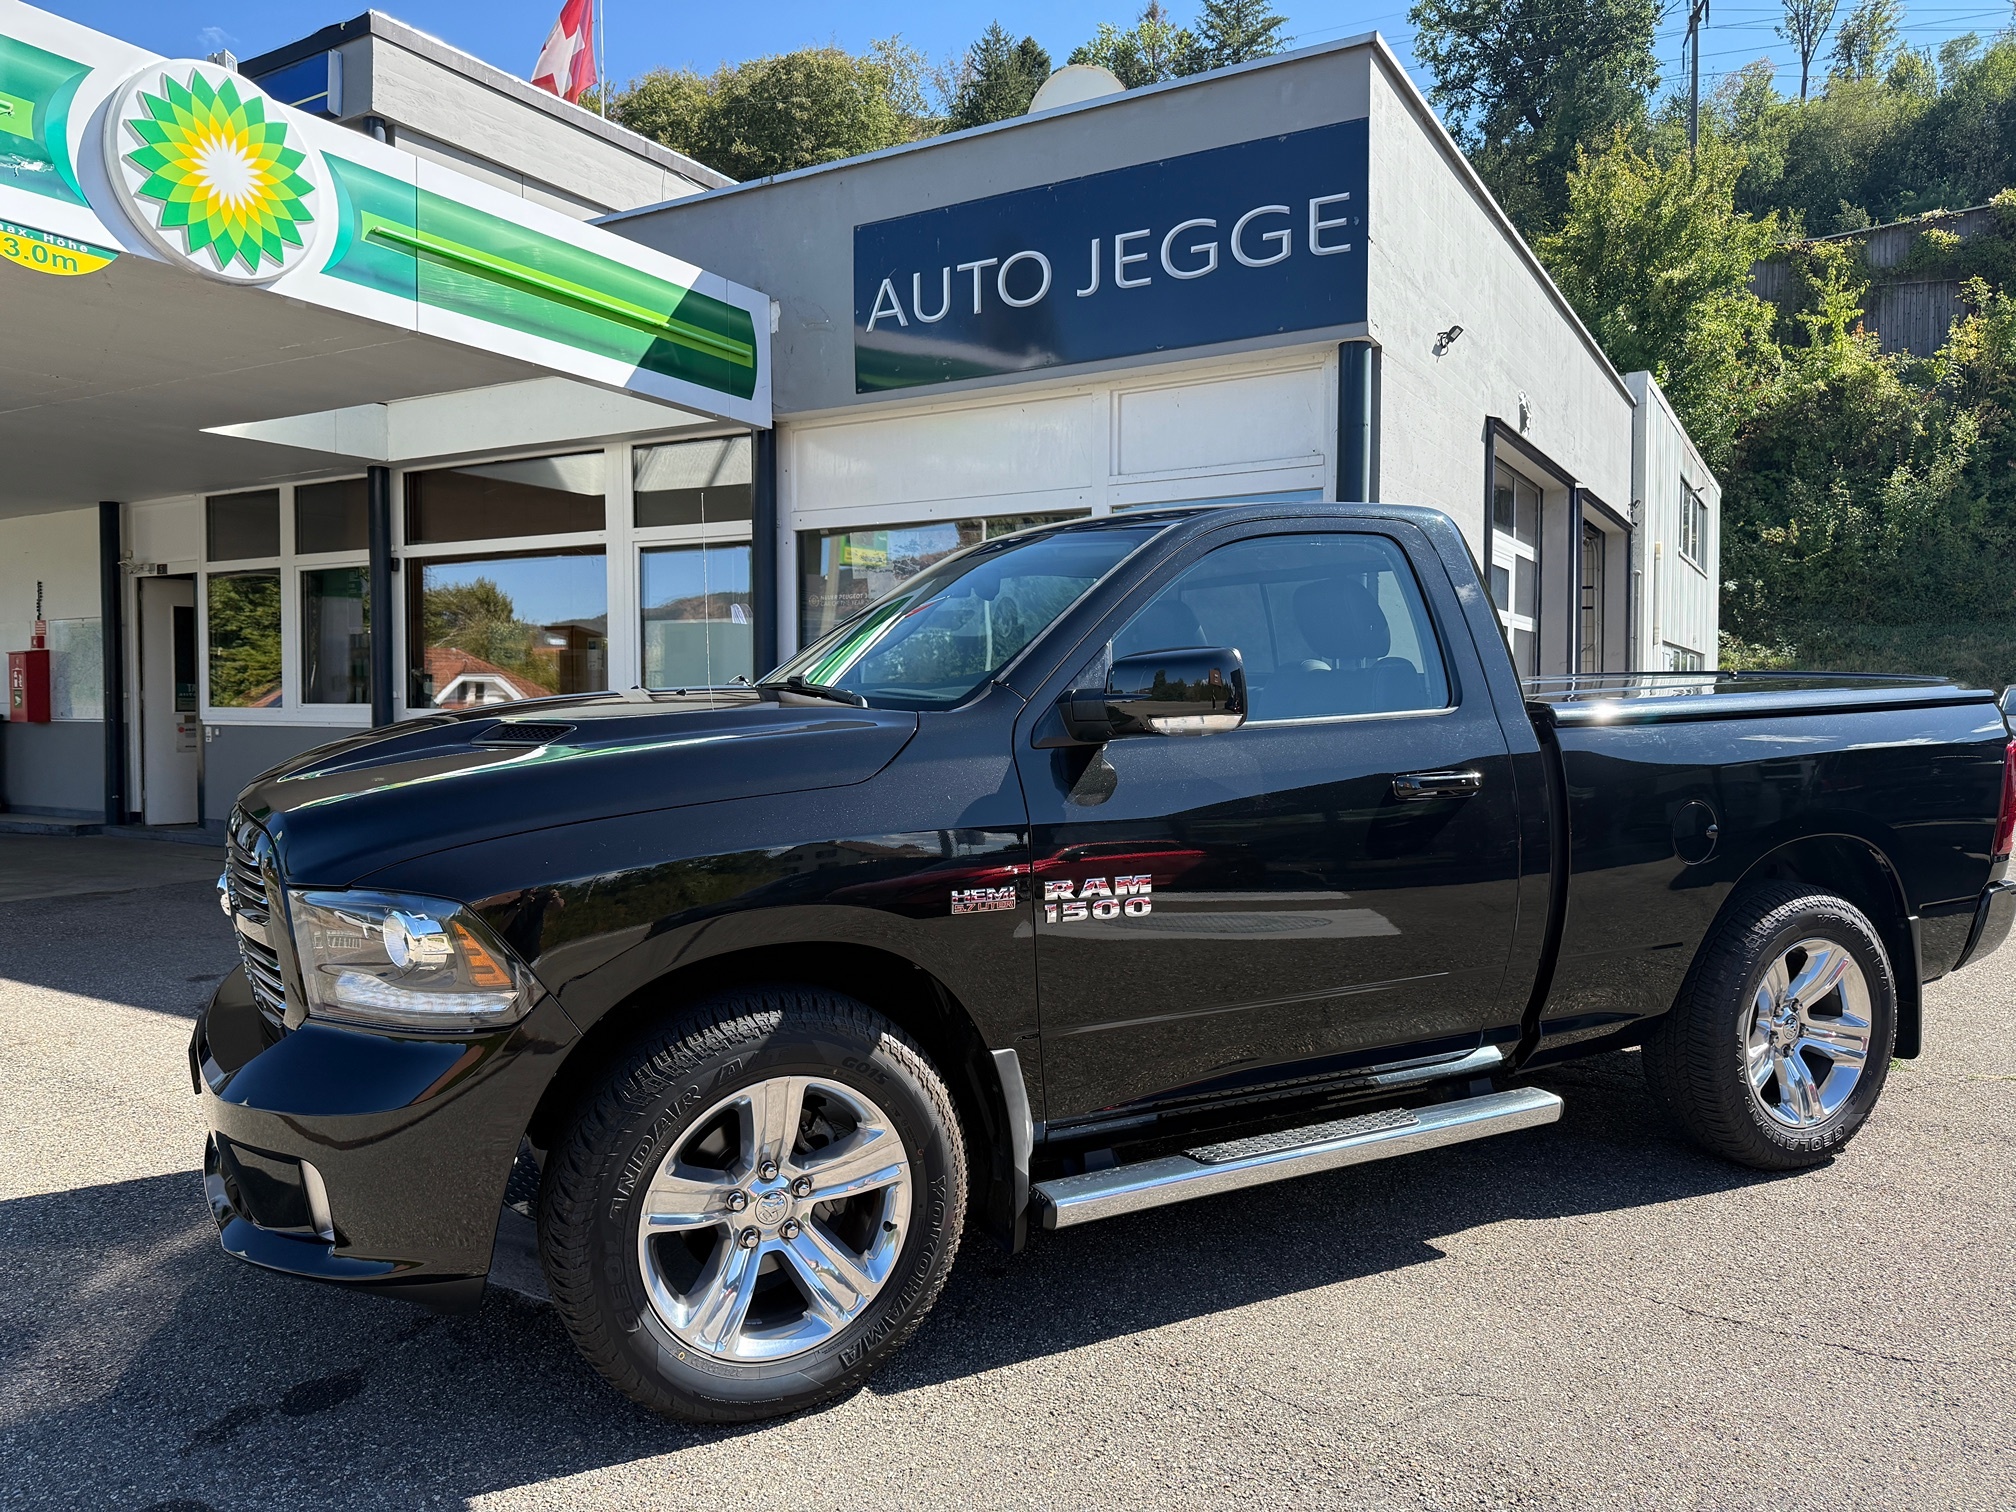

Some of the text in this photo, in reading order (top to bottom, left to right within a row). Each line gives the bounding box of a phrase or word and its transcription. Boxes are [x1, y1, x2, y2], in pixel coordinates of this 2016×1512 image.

[3, 237, 78, 272] 3.0m
[43, 233, 88, 253] Höhe
[866, 191, 1351, 333] AUTO JEGGE
[951, 885, 1016, 904] HEMI
[1044, 873, 1153, 901] RAM
[954, 899, 1014, 913] 5.7 LITER
[1044, 896, 1153, 923] 1500
[1744, 1093, 1846, 1152] GEOLANDAR
[604, 1084, 703, 1333] GEOLANDAR
[838, 1174, 947, 1370] YOKOHAMA
